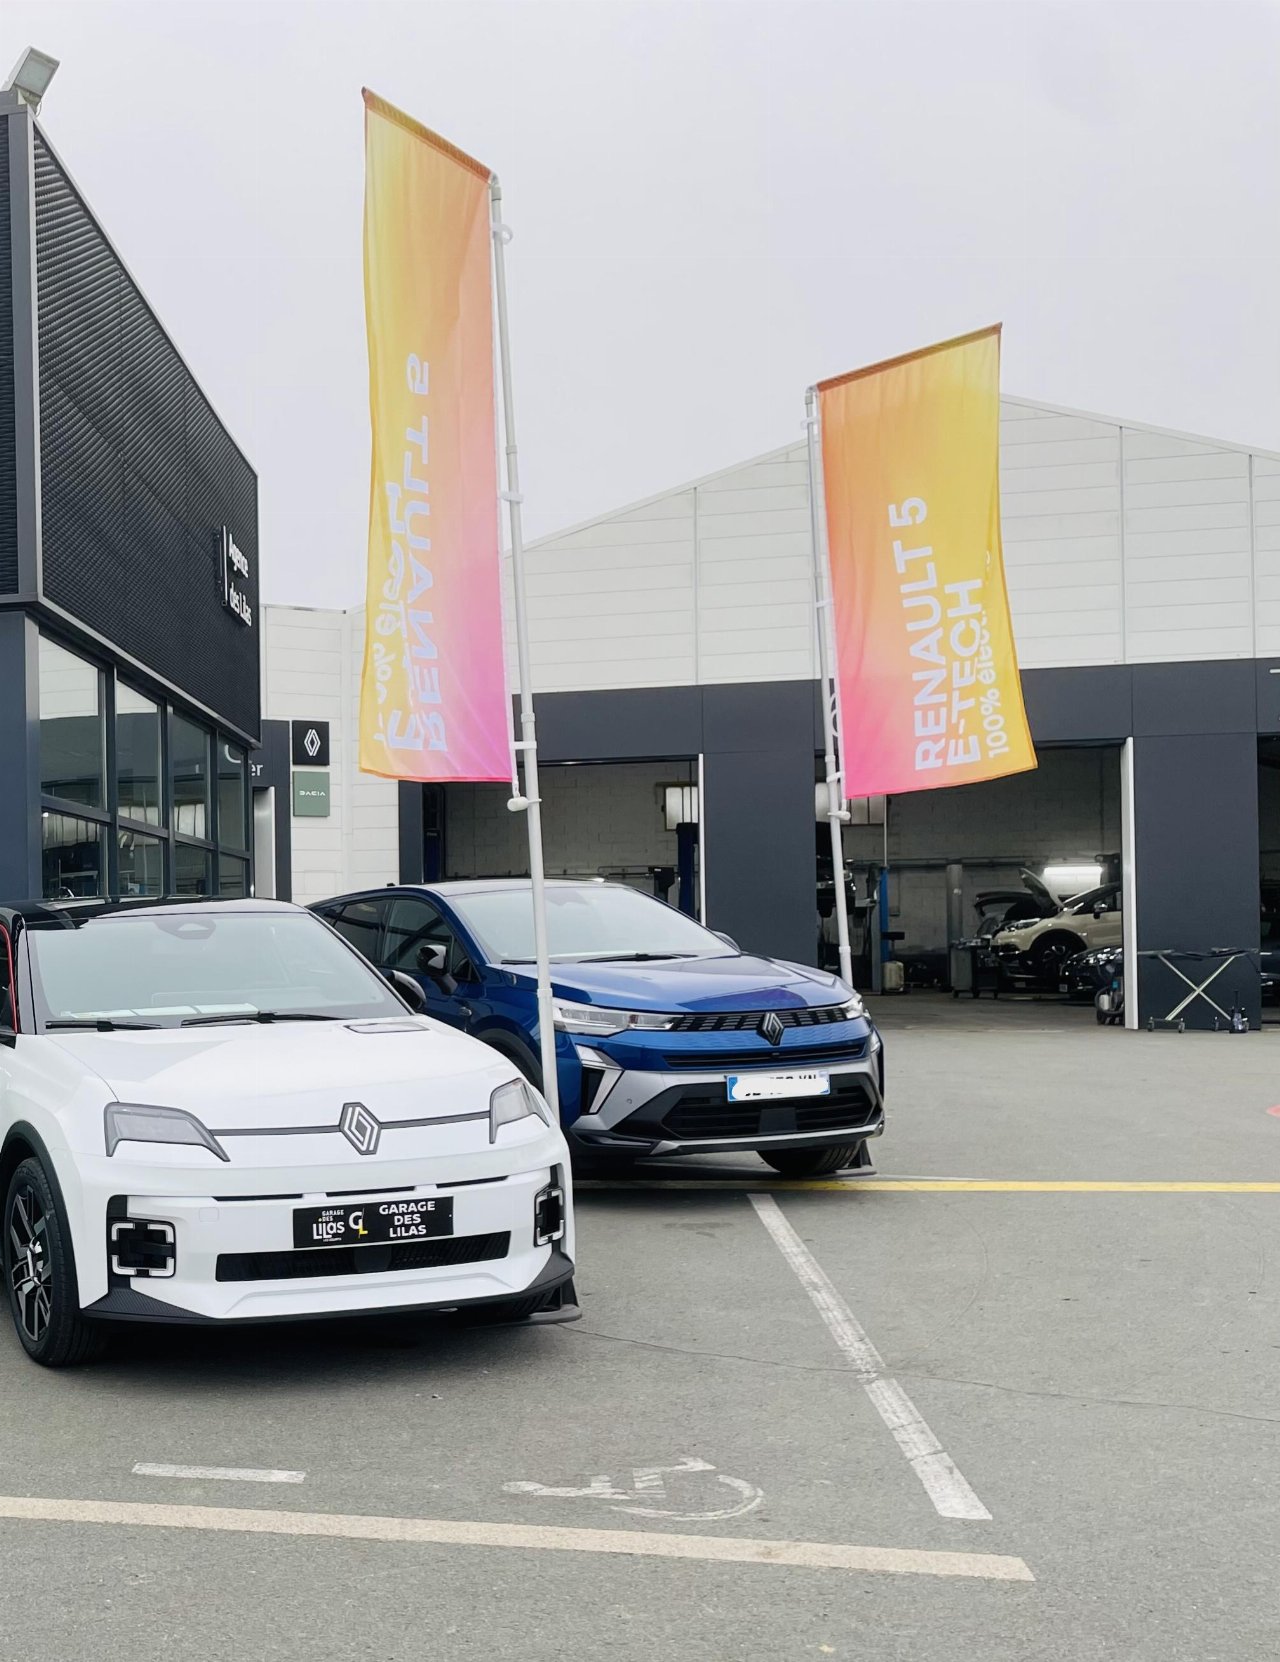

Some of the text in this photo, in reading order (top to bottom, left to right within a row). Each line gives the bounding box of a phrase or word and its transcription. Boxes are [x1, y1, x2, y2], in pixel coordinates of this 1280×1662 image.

[888, 496, 948, 771] RENAULT 5
[943, 578, 982, 766] E-TECH
[980, 688, 1011, 759] 100%
[379, 1201, 436, 1215] GARAGE
[394, 1213, 422, 1226] DES
[389, 1224, 427, 1238] LILAS
